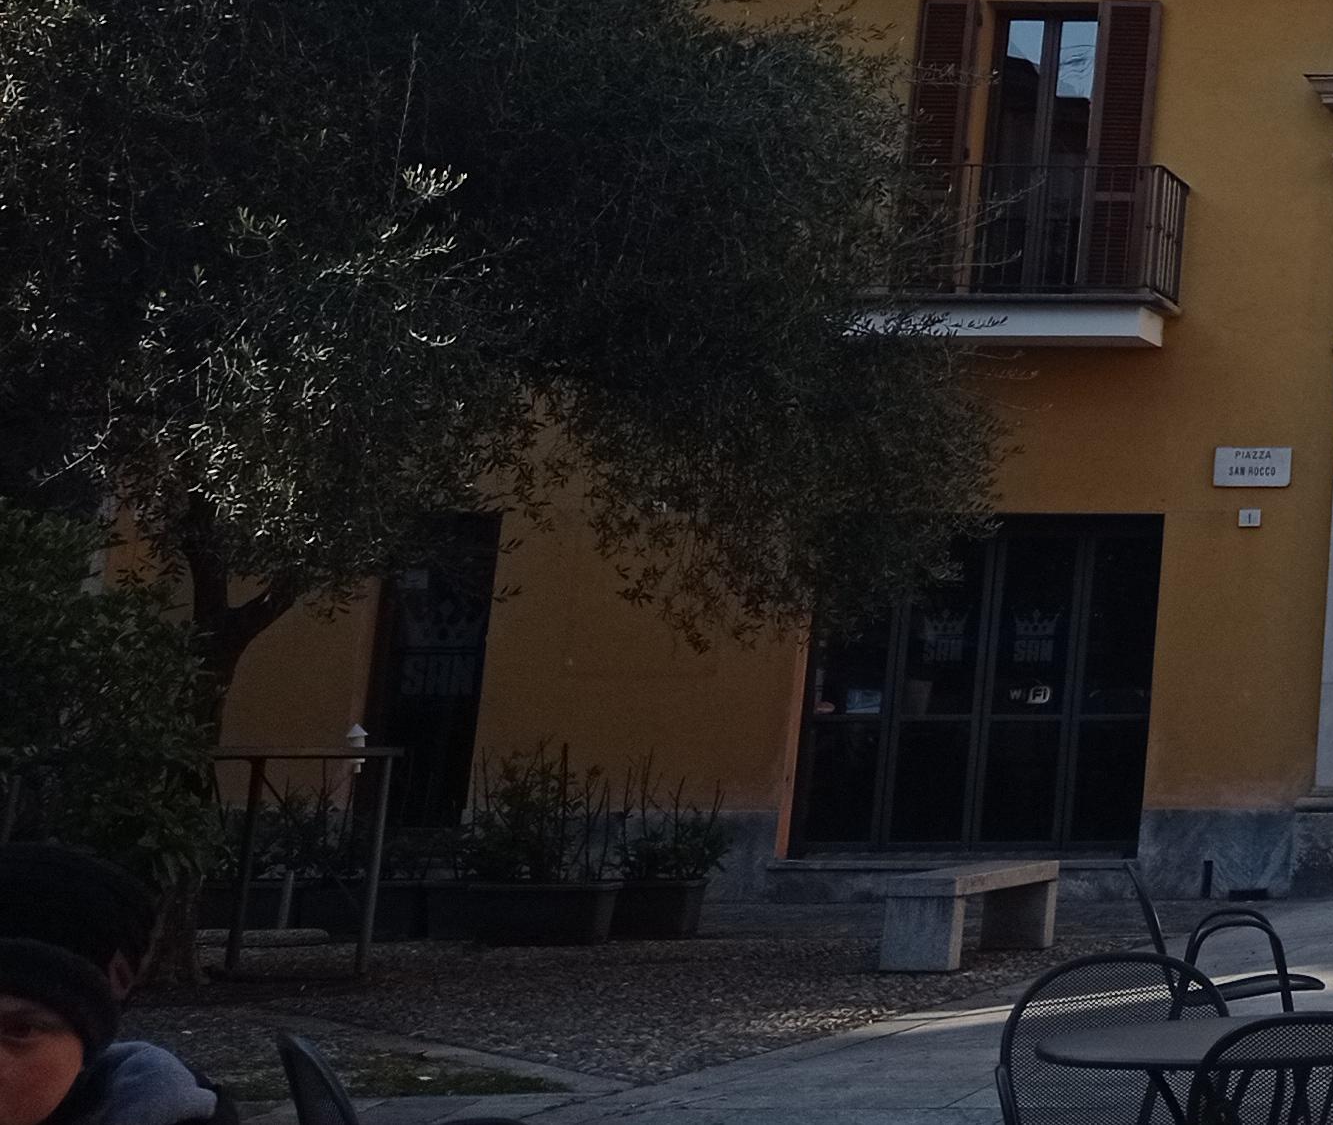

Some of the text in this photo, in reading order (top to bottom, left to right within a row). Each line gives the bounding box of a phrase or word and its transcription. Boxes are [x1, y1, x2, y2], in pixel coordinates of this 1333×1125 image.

[1234, 450, 1271, 460] PIAZZA
[1229, 466, 1276, 477] SAN ROCCO
[1013, 640, 1054, 662] SAN
[400, 654, 477, 697] SAN
